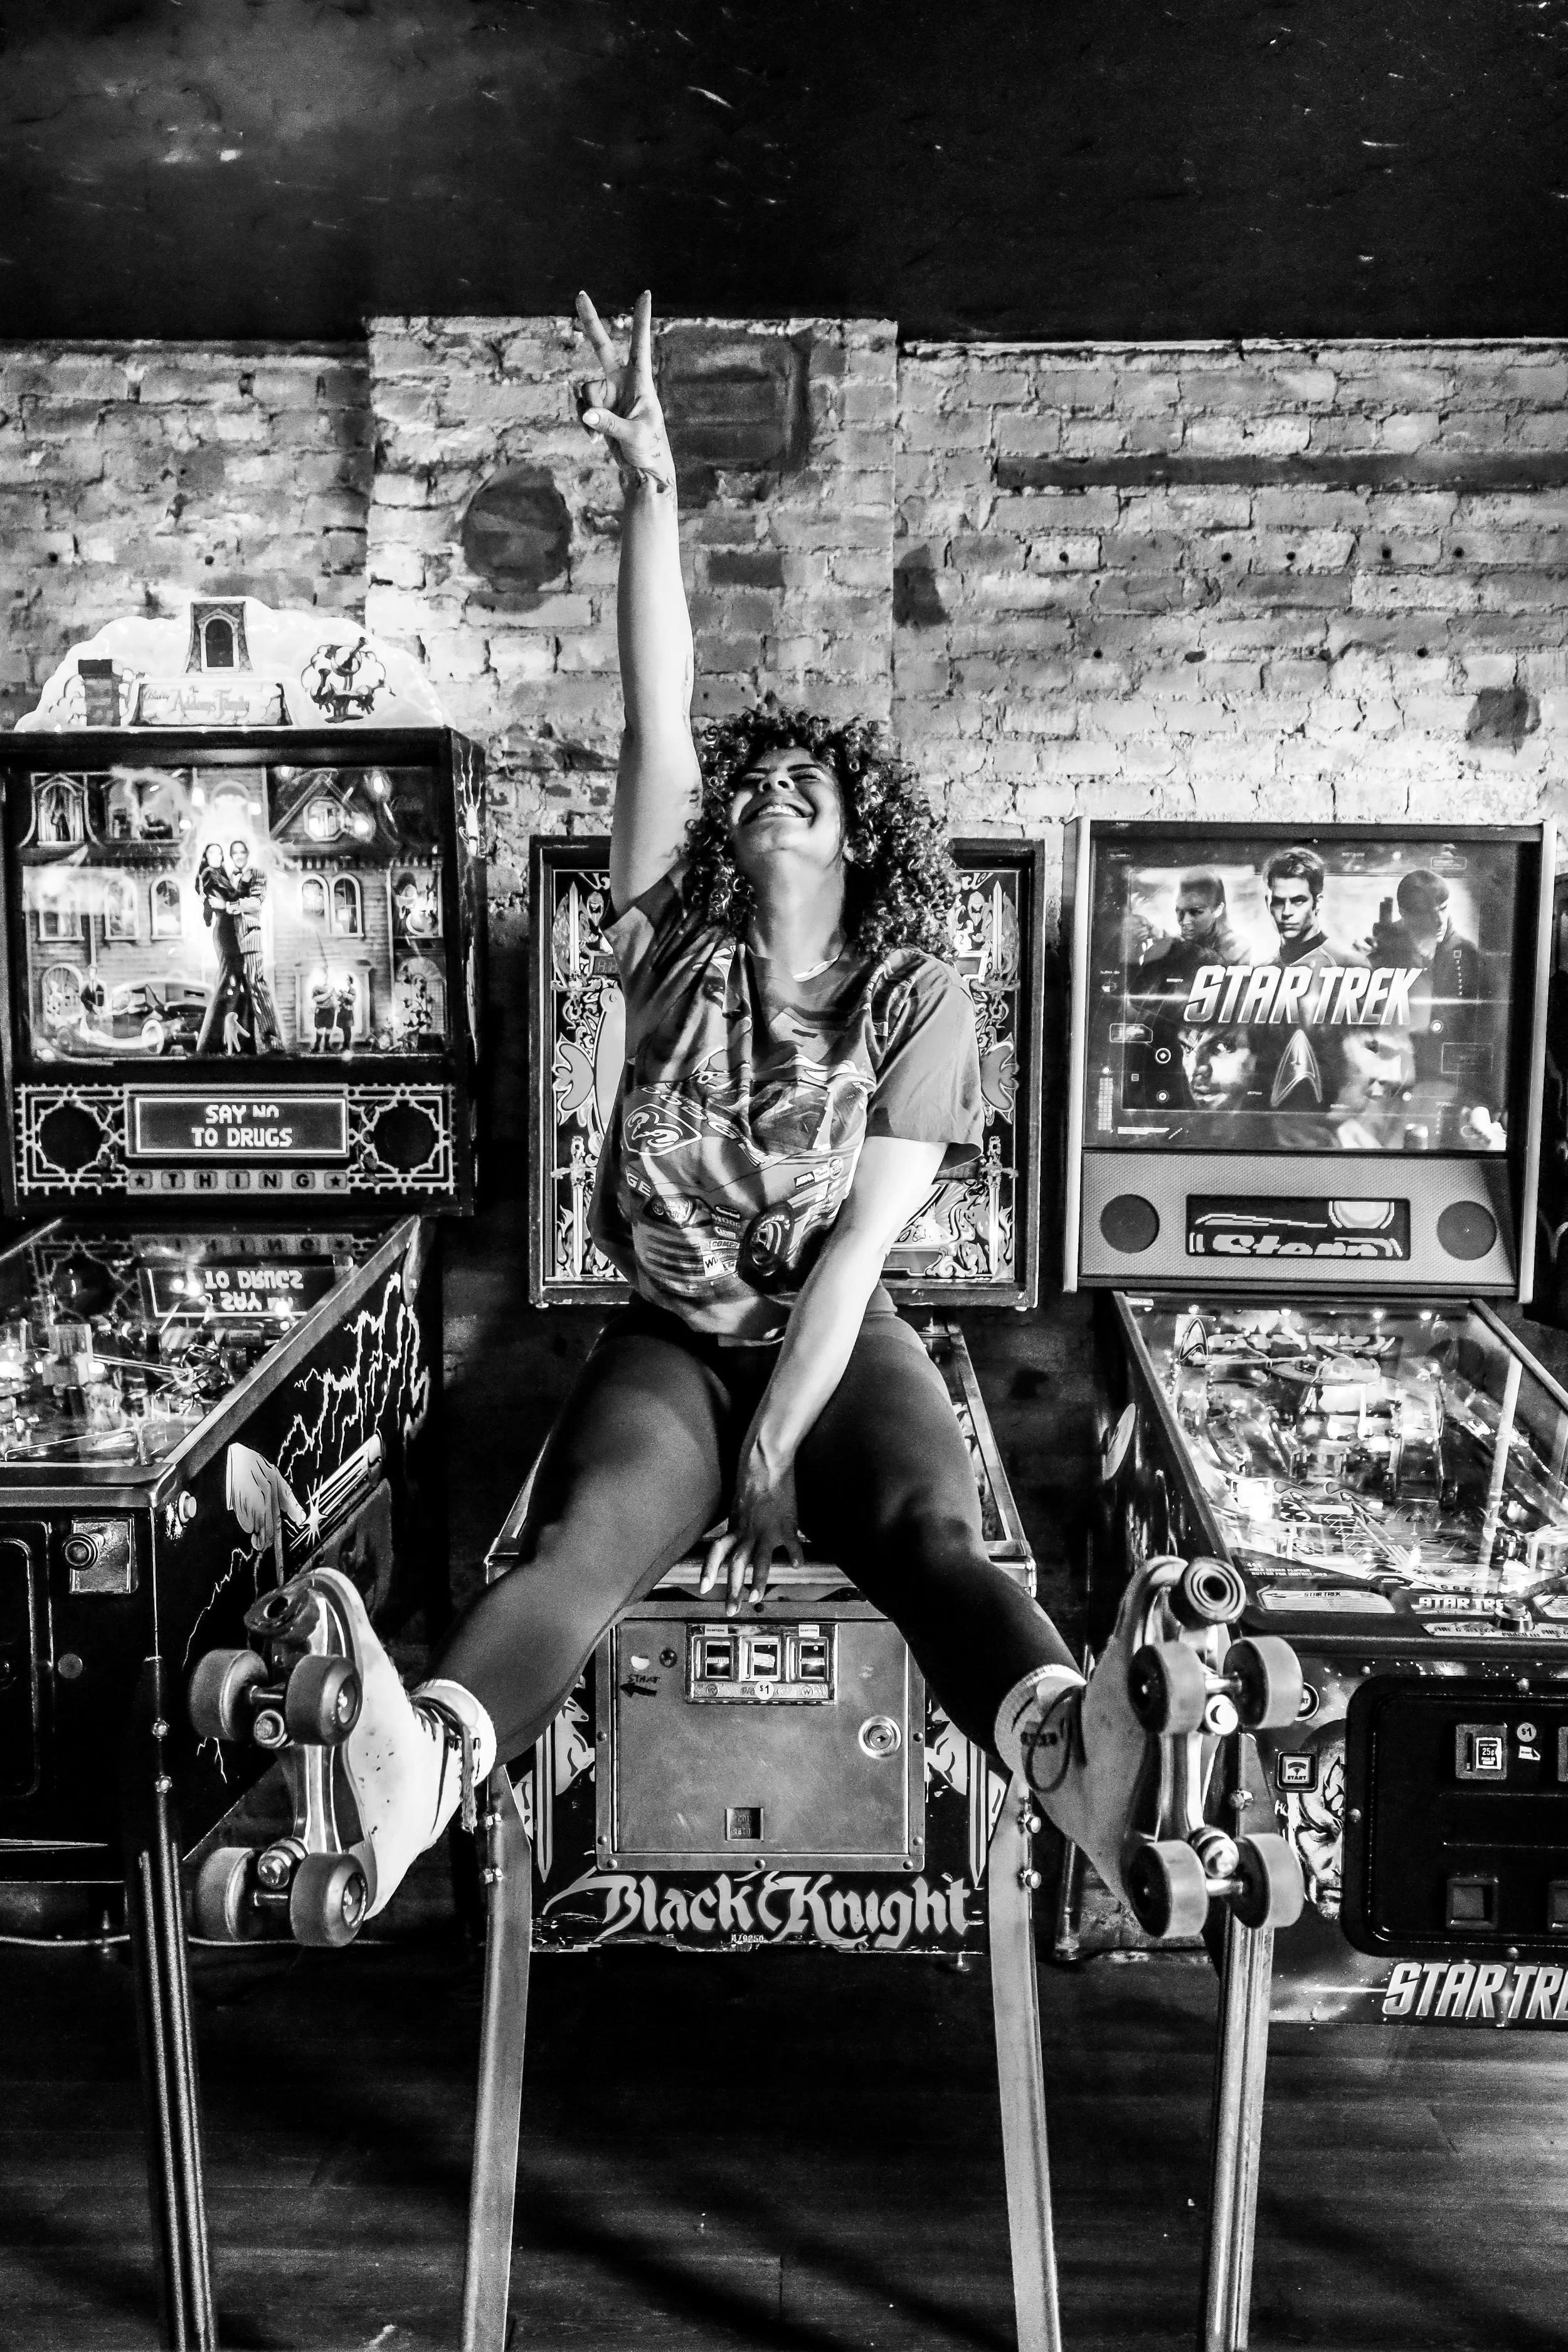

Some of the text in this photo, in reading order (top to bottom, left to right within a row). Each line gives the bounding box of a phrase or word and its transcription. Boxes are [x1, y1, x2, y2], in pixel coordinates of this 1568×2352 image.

[144, 688, 171, 701] Bally
[1184, 965, 1424, 1025] STAR TREK
[206, 1104, 246, 1123] SAY
[192, 1128, 292, 1147] TO DRUGS
[1419, 1597, 1504, 1610] STAR TRE
[628, 1674, 661, 1683] START
[760, 1685, 770, 1694] $1
[1521, 1727, 1532, 1737] $1
[1482, 1747, 1495, 1756] 25¢
[543, 1868, 971, 1948] Black Knight
[1382, 1963, 1568, 2020] STAR TR
